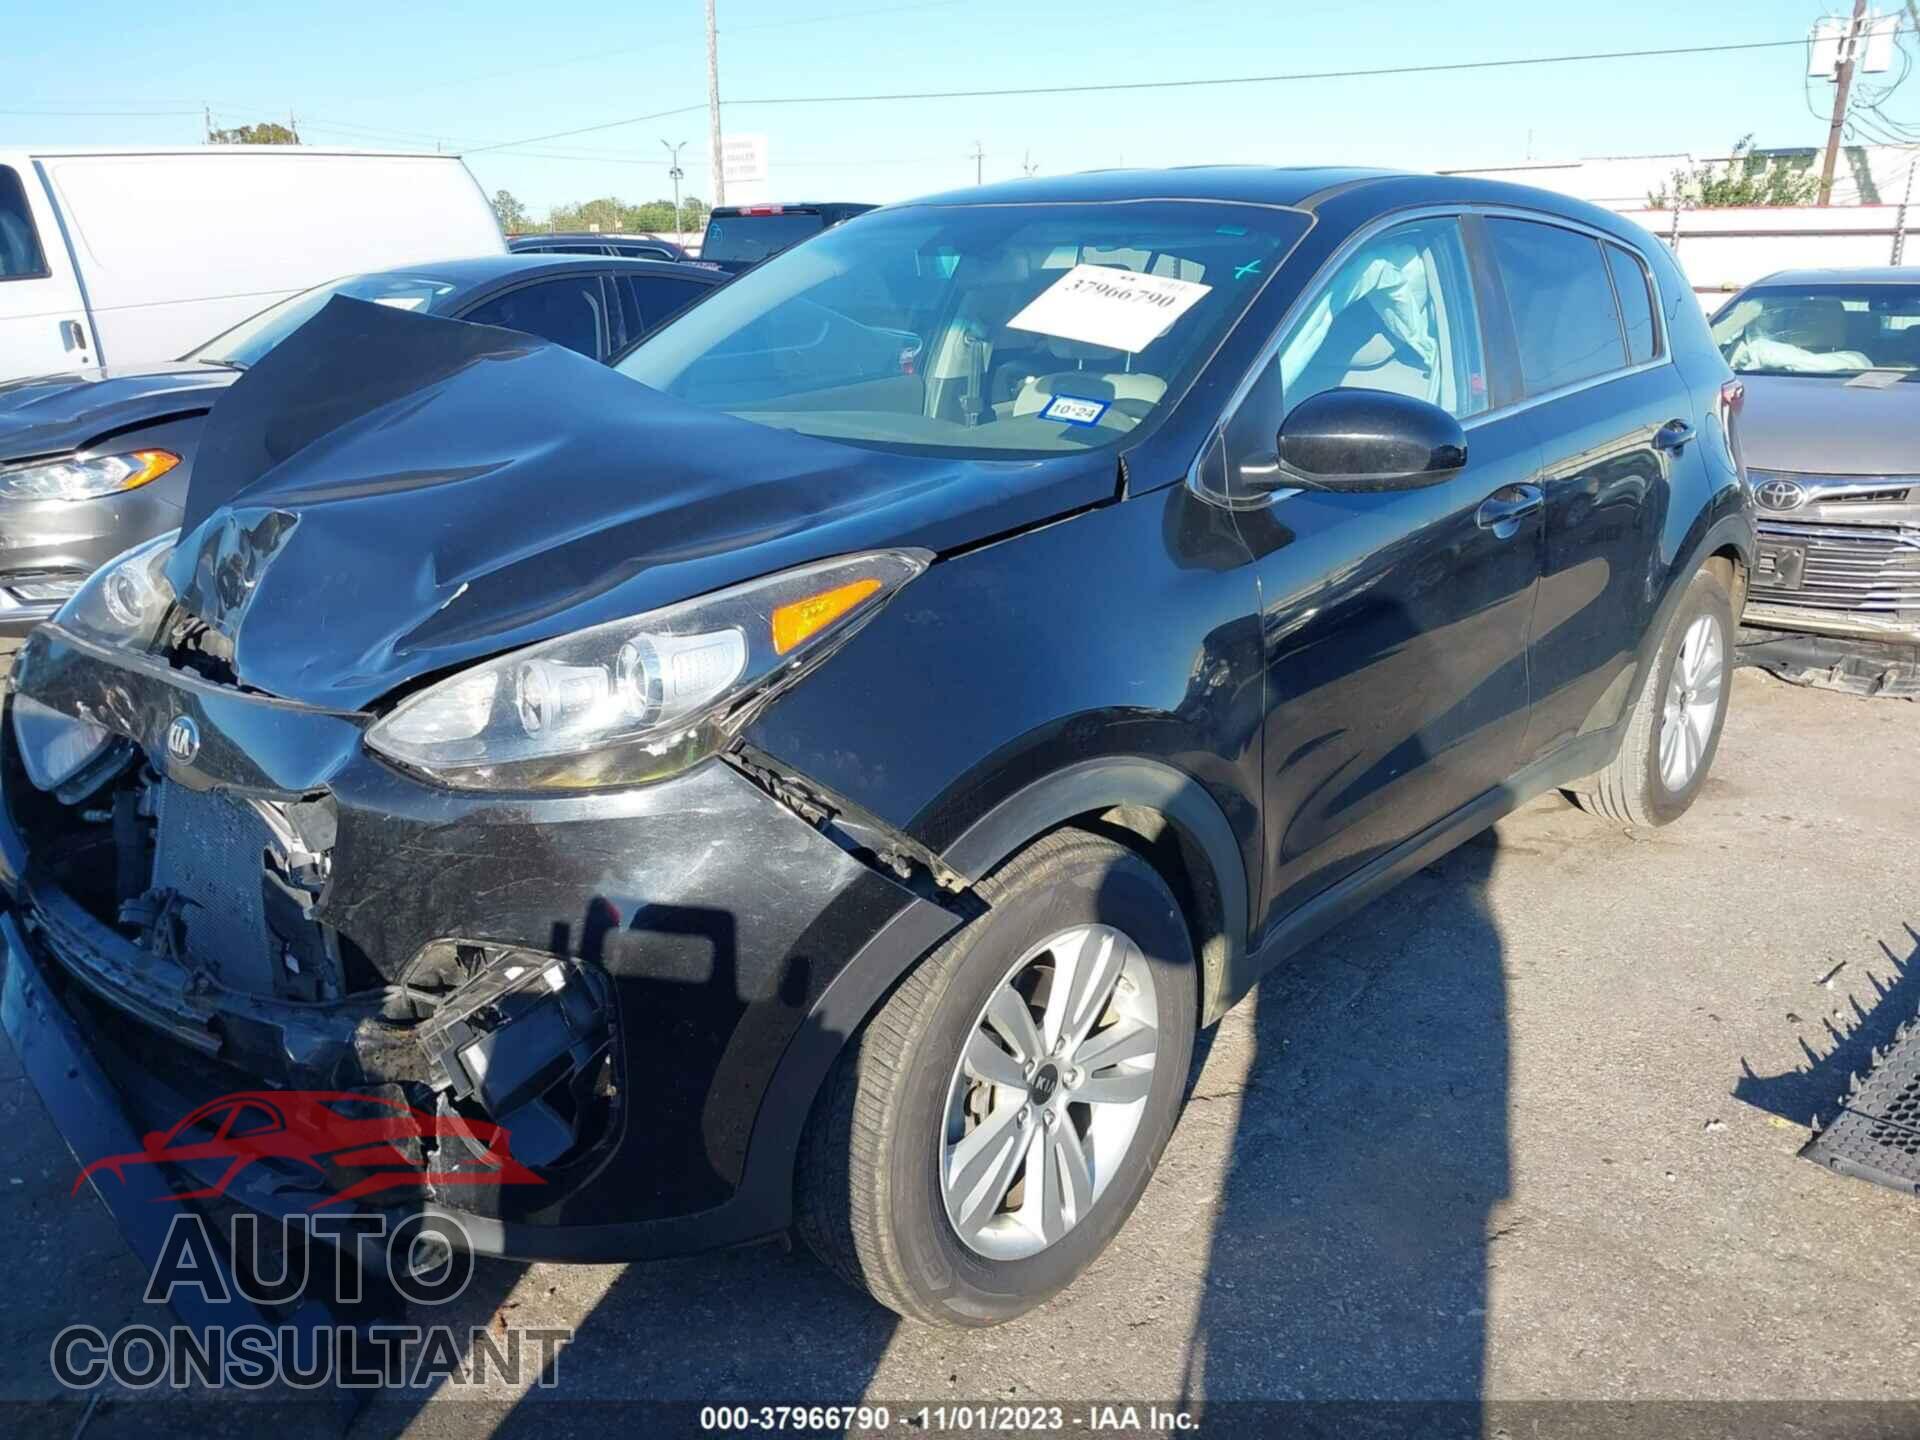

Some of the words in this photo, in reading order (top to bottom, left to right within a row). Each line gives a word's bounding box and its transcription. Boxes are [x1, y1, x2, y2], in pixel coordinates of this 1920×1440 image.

[1063, 278, 1176, 309] 37966790
[170, 721, 191, 756] KIA
[1035, 1074, 1056, 1093] KIA
